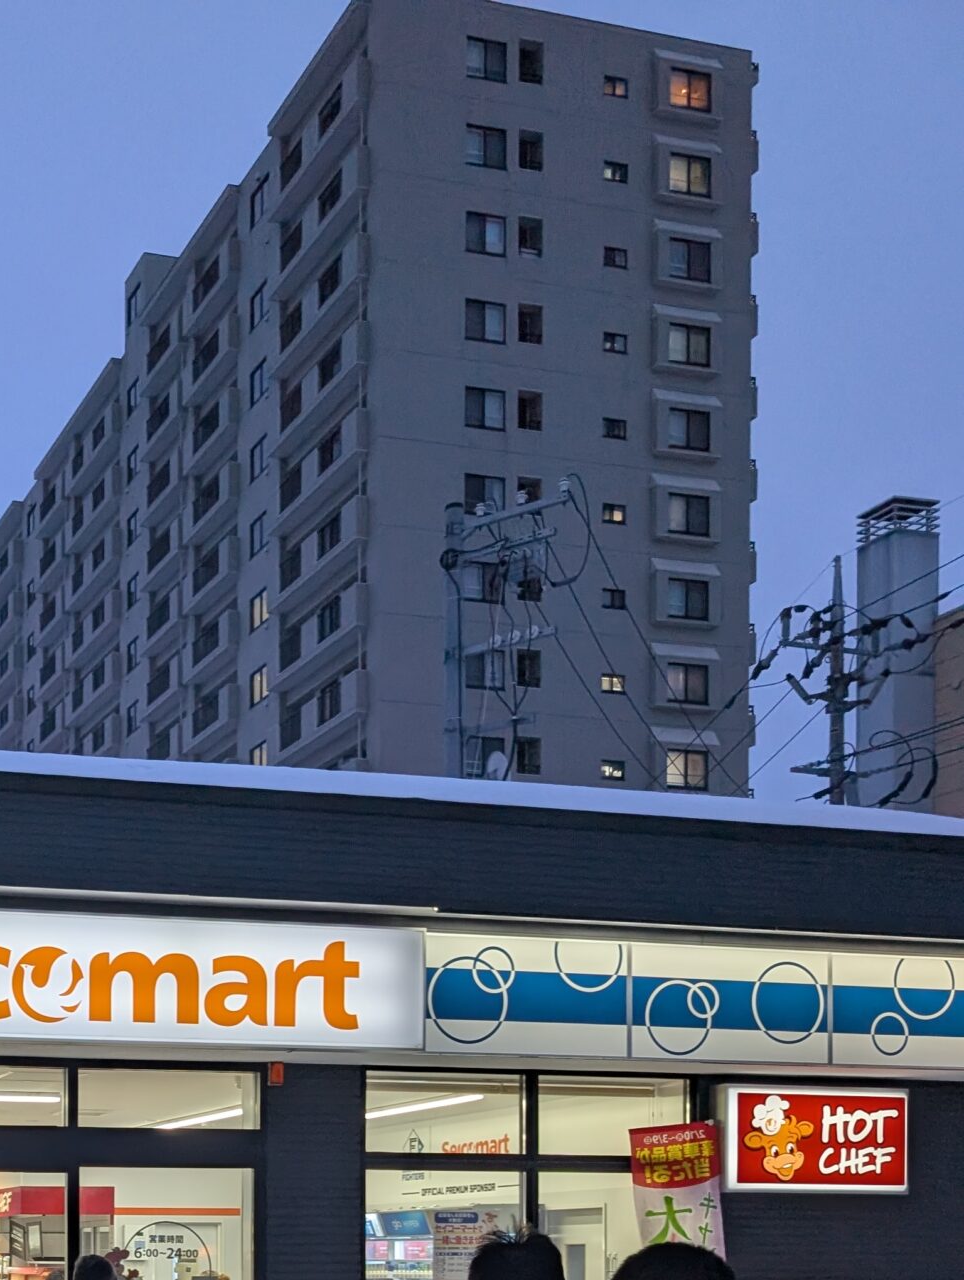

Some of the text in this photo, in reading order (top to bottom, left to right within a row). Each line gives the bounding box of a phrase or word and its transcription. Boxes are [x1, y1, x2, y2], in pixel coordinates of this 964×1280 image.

[821, 1104, 899, 1144] HOT
[818, 1145, 896, 1175] CHEF
[421, 1182, 496, 1197] OFFICIAL PREMIUM SPONSOR
[149, 1234, 184, 1244] 営業時間
[133, 1247, 199, 1260] 6:00～24:00
